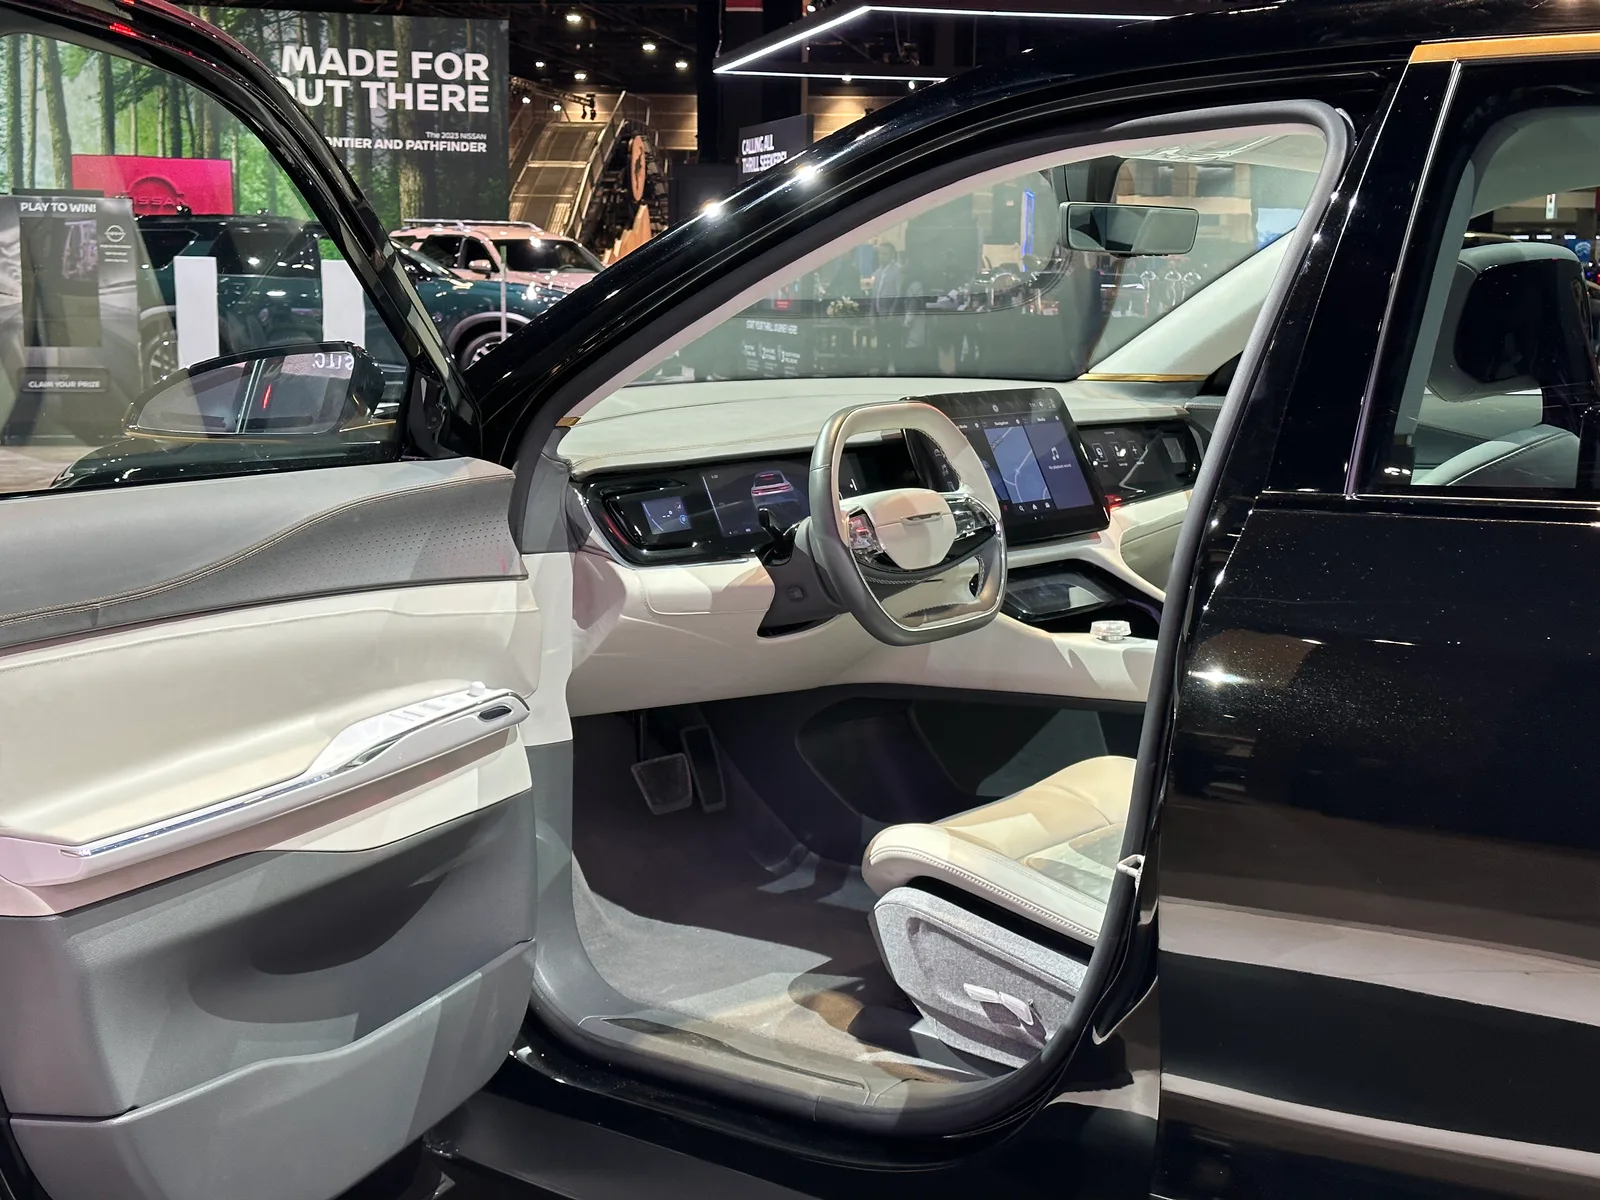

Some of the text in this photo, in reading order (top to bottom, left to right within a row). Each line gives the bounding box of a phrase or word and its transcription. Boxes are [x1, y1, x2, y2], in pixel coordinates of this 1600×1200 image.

[281, 45, 490, 81] MADE FOR
[361, 81, 490, 113] THERE
[425, 131, 487, 141] The 2023 NISSAN
[374, 138, 403, 150] AND
[405, 140, 487, 153] PATHFINDER
[742, 133, 775, 155] CALLING ALL
[20, 202, 97, 213] PLAY TO WIN!
[28, 380, 100, 389] CLAIM YOUR PRIZE
